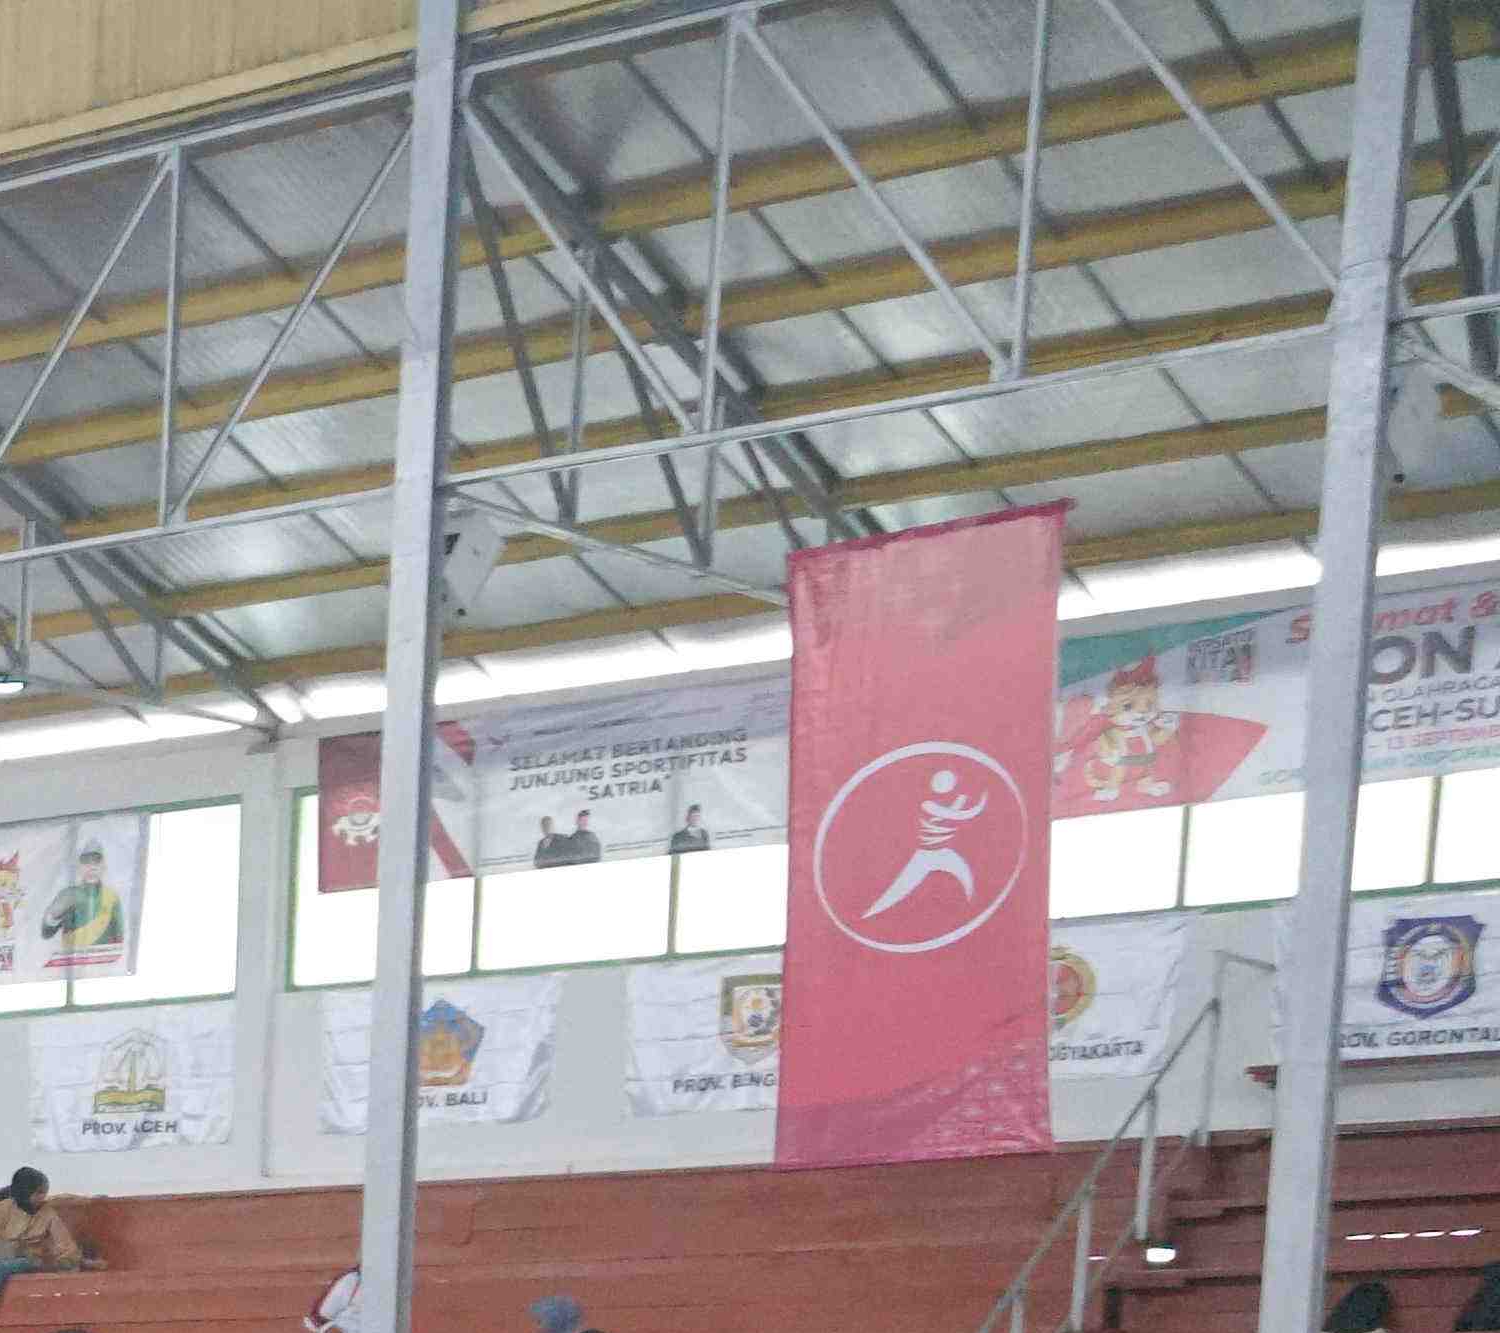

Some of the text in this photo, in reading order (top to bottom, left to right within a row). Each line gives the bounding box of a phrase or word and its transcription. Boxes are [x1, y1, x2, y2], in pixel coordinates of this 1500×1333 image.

[508, 747, 607, 771] SELAMAT
[508, 766, 604, 791] JUNJUNG
[1386, 1027, 1500, 1048] GORONTAL
